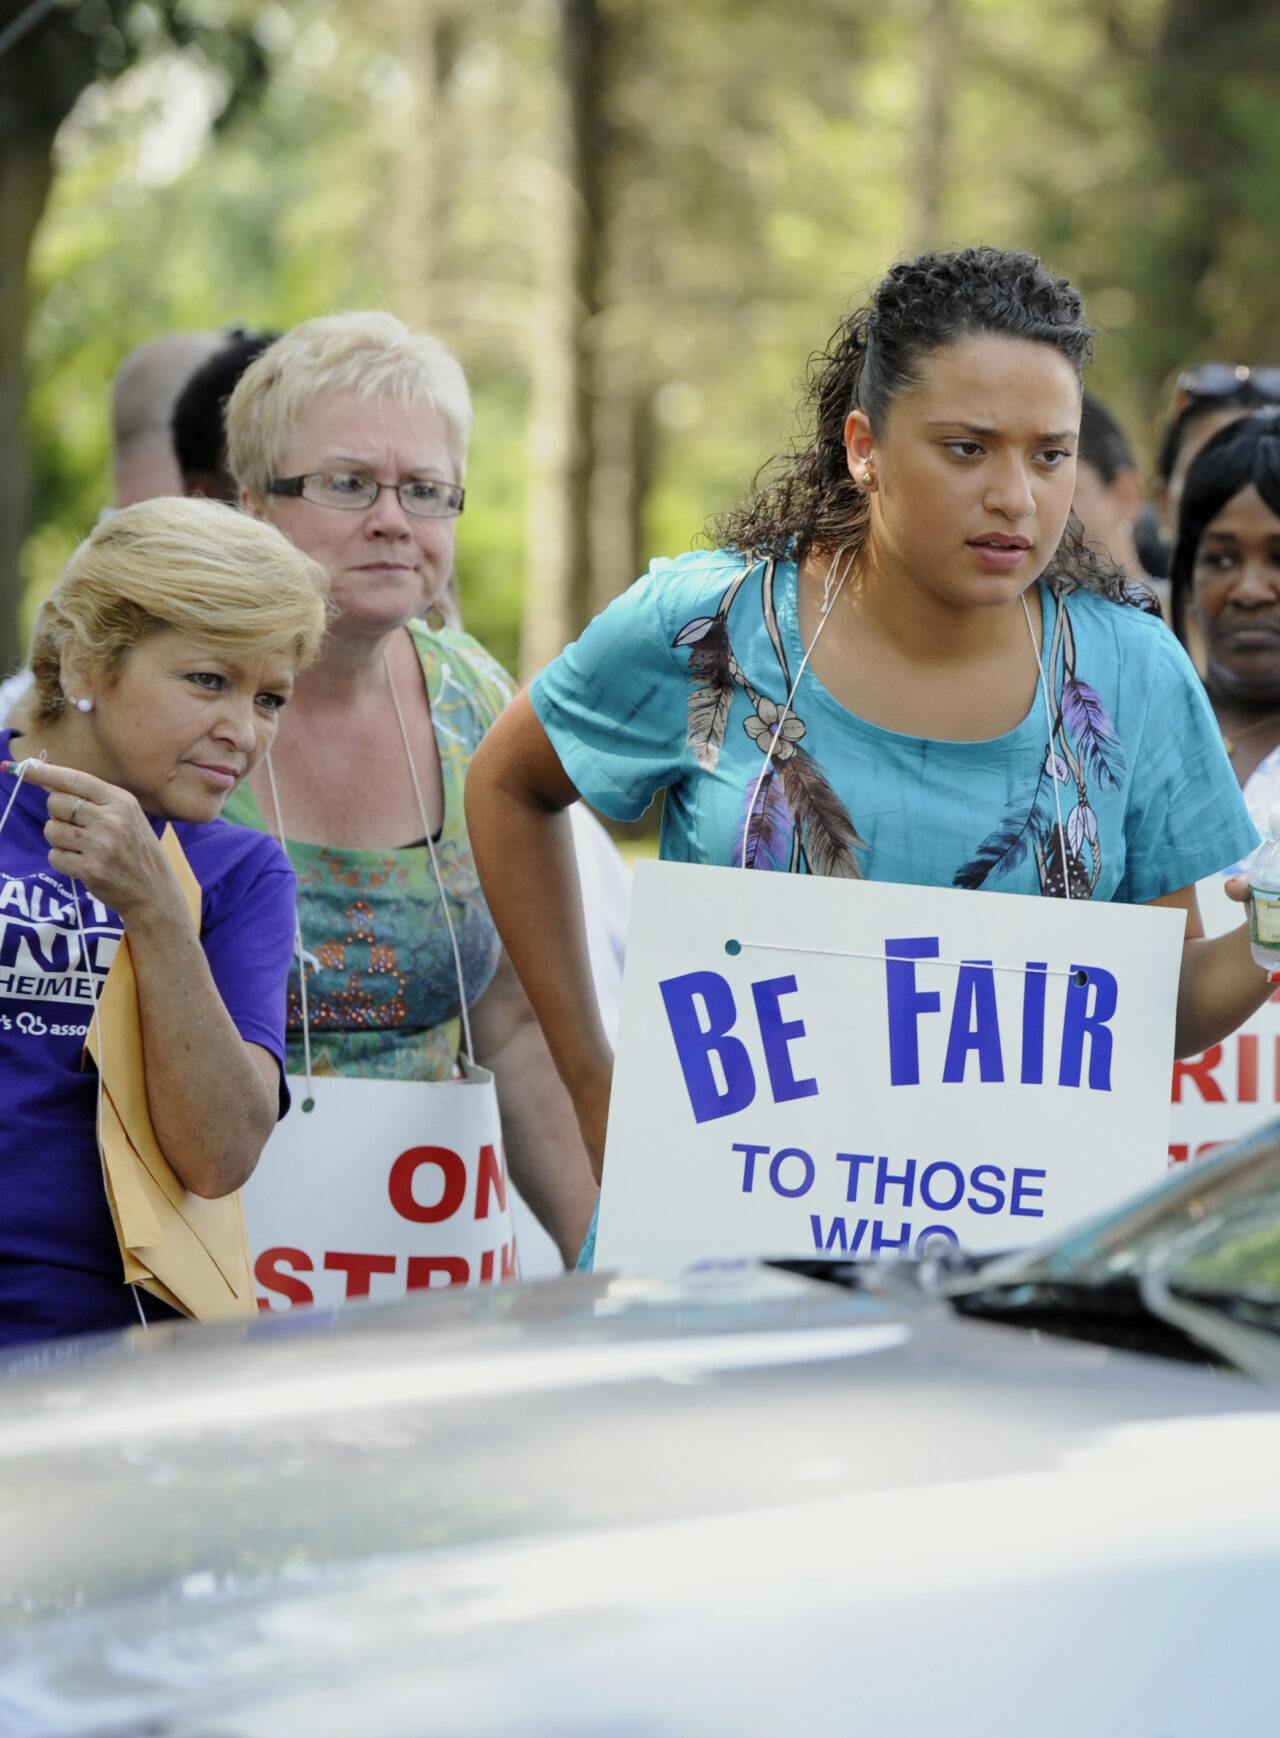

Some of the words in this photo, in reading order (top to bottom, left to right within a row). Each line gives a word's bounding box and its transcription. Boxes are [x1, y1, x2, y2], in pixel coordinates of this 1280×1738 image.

[0, 881, 76, 925] ALK
[50, 1024, 91, 1036] asso
[659, 970, 819, 1124] BE
[885, 936, 1118, 1092] FAIR
[731, 1143, 815, 1198] TO
[835, 1152, 1046, 1217] THOSE
